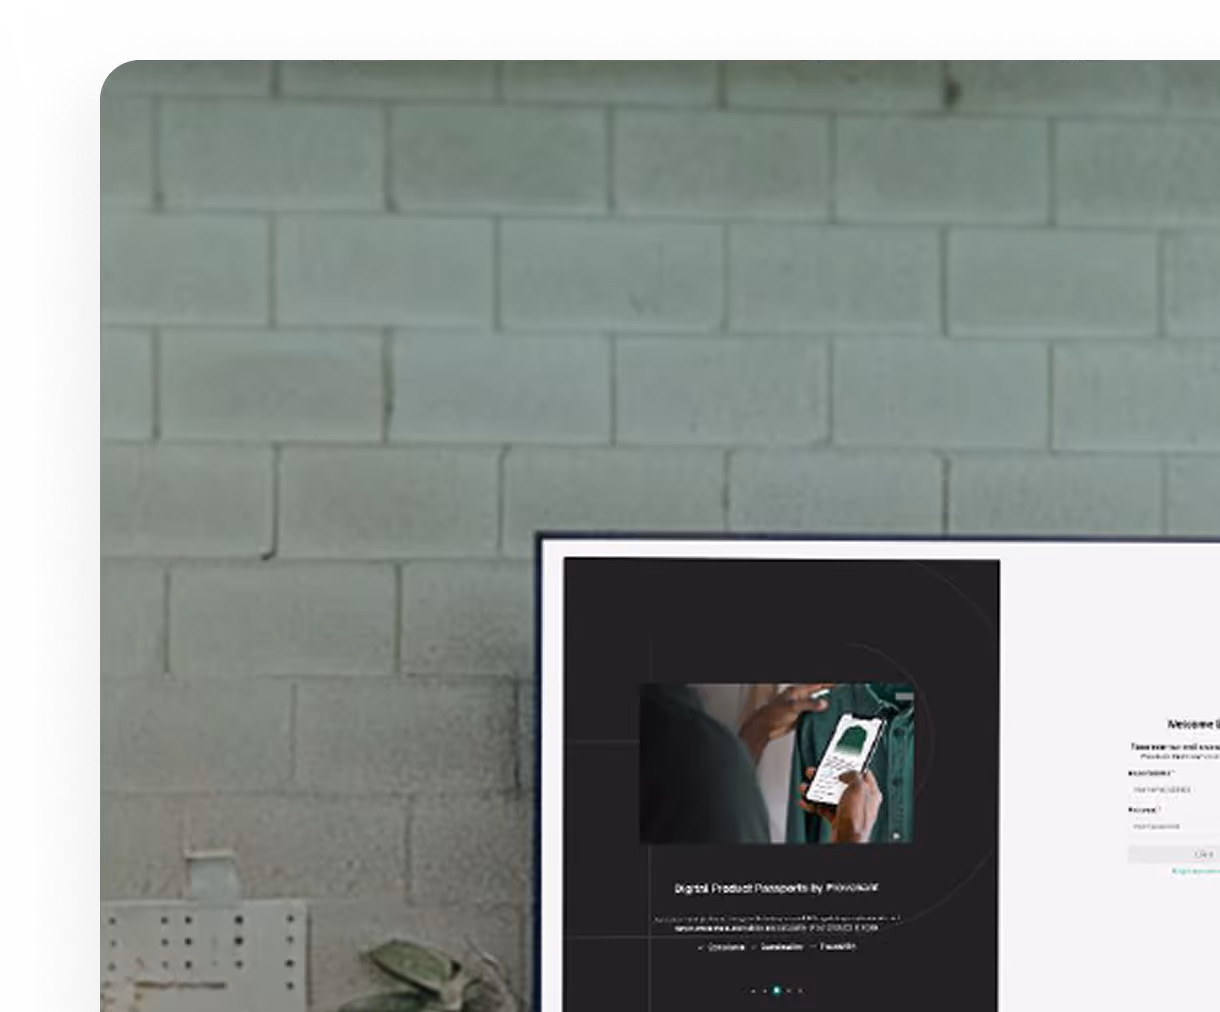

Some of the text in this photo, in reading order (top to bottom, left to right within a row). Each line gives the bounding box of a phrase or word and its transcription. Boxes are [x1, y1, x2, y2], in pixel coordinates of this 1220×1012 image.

[674, 882, 709, 896] Digital
[711, 882, 753, 895] Product
[754, 882, 809, 896] Passports
